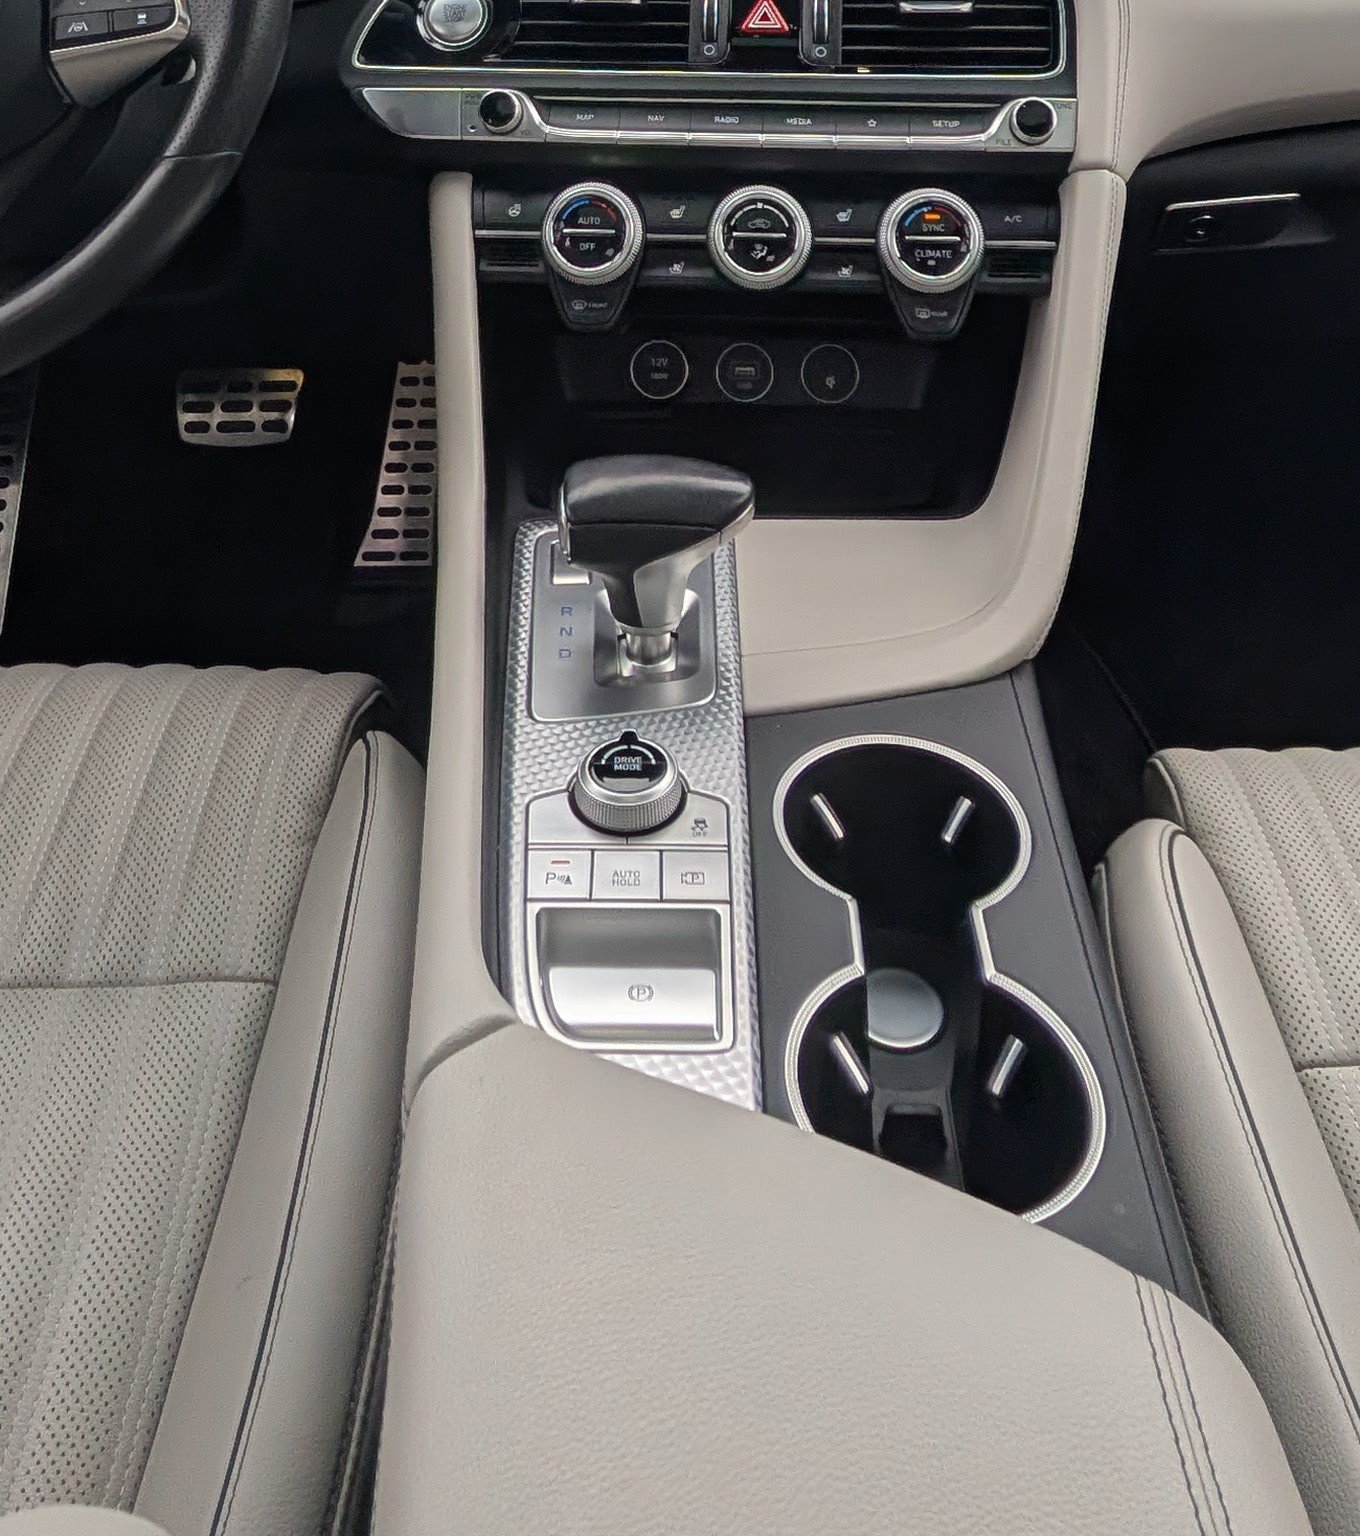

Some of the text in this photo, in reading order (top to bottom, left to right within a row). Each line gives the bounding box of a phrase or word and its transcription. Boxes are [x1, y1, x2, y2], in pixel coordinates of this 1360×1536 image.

[576, 113, 595, 121] MAP
[648, 115, 665, 123] NAV
[714, 116, 739, 124] RADIO
[786, 117, 812, 125] MEDIA
[932, 119, 960, 128] SETUP
[578, 216, 601, 225] AUTO
[1005, 214, 1022, 224] A/C
[922, 223, 945, 232] SYNC
[580, 242, 595, 251] OFF
[915, 249, 953, 259] CLIMATE
[651, 357, 668, 366] 12V
[561, 606, 572, 616] R
[560, 626, 572, 636] N
[614, 756, 642, 764] DRIVE
[614, 763, 642, 771] MODE
[612, 870, 640, 878] AUTO
[612, 877, 640, 886] HOLD
